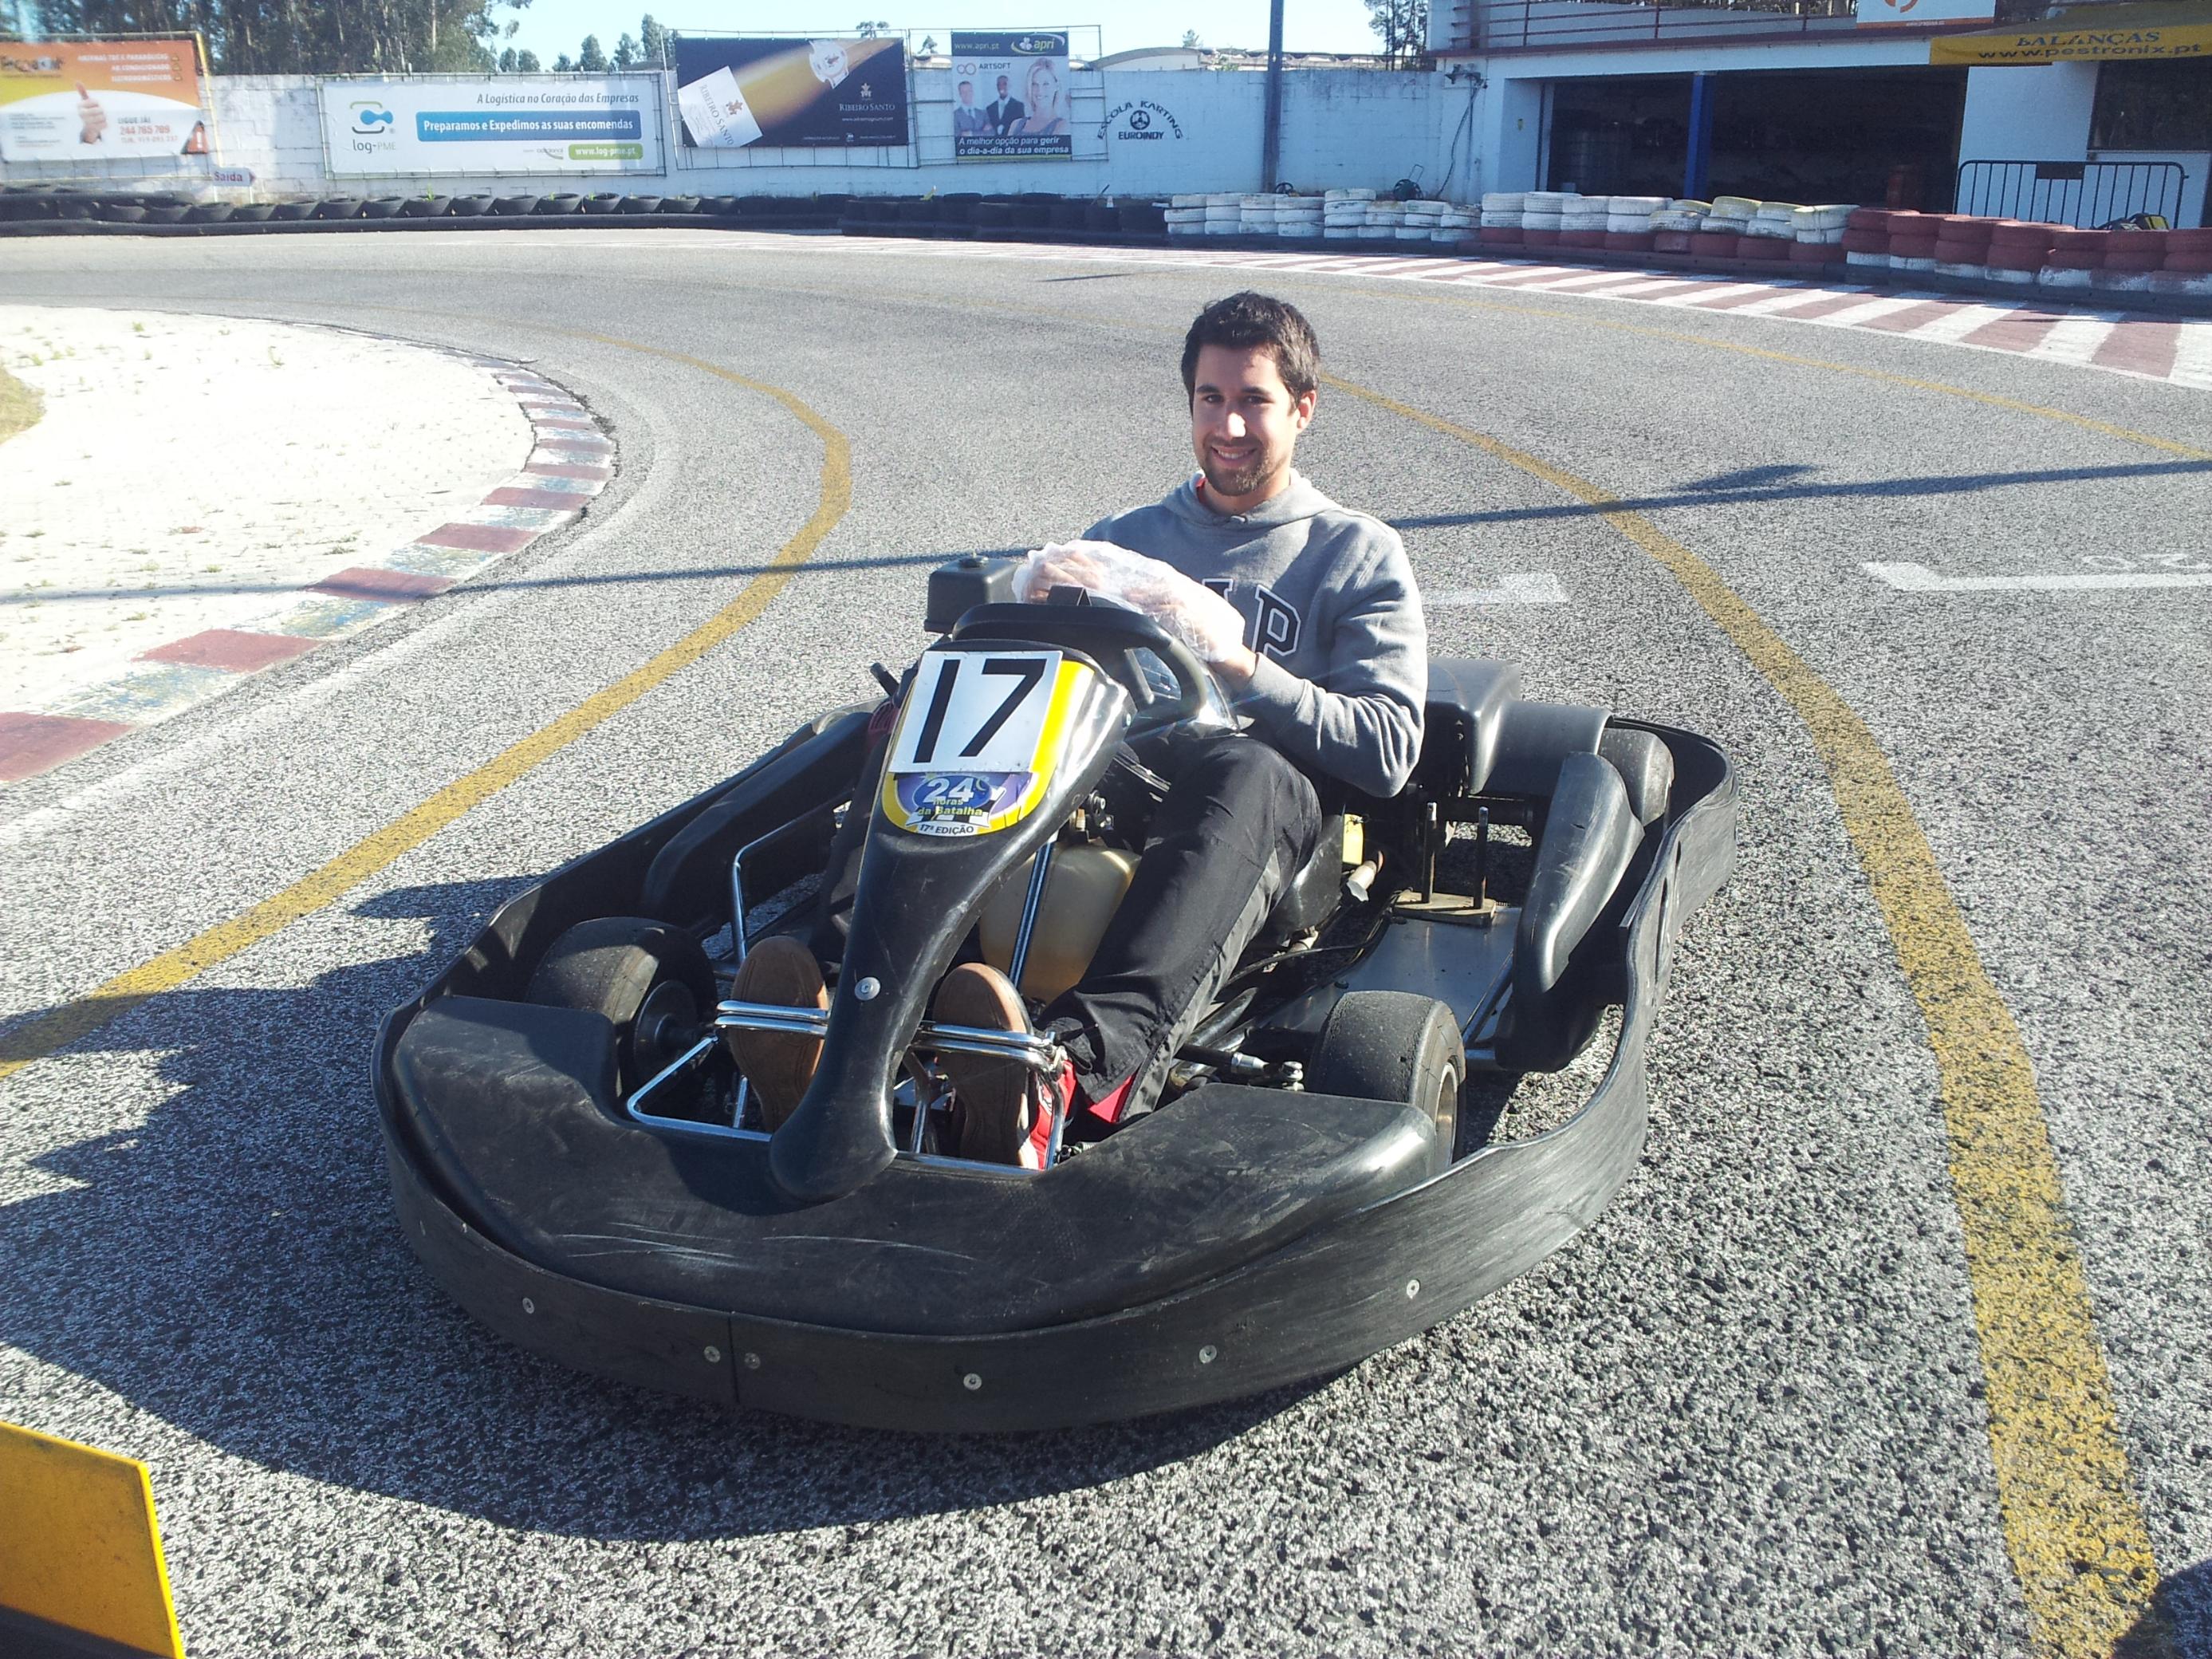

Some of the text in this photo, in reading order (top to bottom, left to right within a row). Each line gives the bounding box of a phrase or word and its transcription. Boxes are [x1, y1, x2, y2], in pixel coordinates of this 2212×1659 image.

[1033, 37, 1055, 52] apri
[477, 92, 640, 106] A Logística no Coração das Empresas
[423, 120, 481, 133] Preparamos
[489, 119, 540, 133] Expedimos
[541, 121, 552, 130] as
[553, 121, 574, 130] suas
[575, 118, 634, 130] encomendas
[1139, 100, 1183, 140] KARTING
[958, 136, 966, 145] A
[966, 136, 994, 145] melhor
[995, 136, 1020, 147] opção
[1040, 136, 1061, 146] gerir
[1118, 131, 1164, 140] EUROINDY
[575, 146, 636, 157] www.log-pme.pt
[966, 147, 1004, 156] dia-a-dia
[1004, 146, 1016, 155] da
[1033, 146, 1069, 155] empresa
[912, 659, 1048, 764] 17
[923, 778, 974, 803] 24
[918, 805, 984, 816] da Batalha
[935, 824, 974, 835] EDIÇÃO
